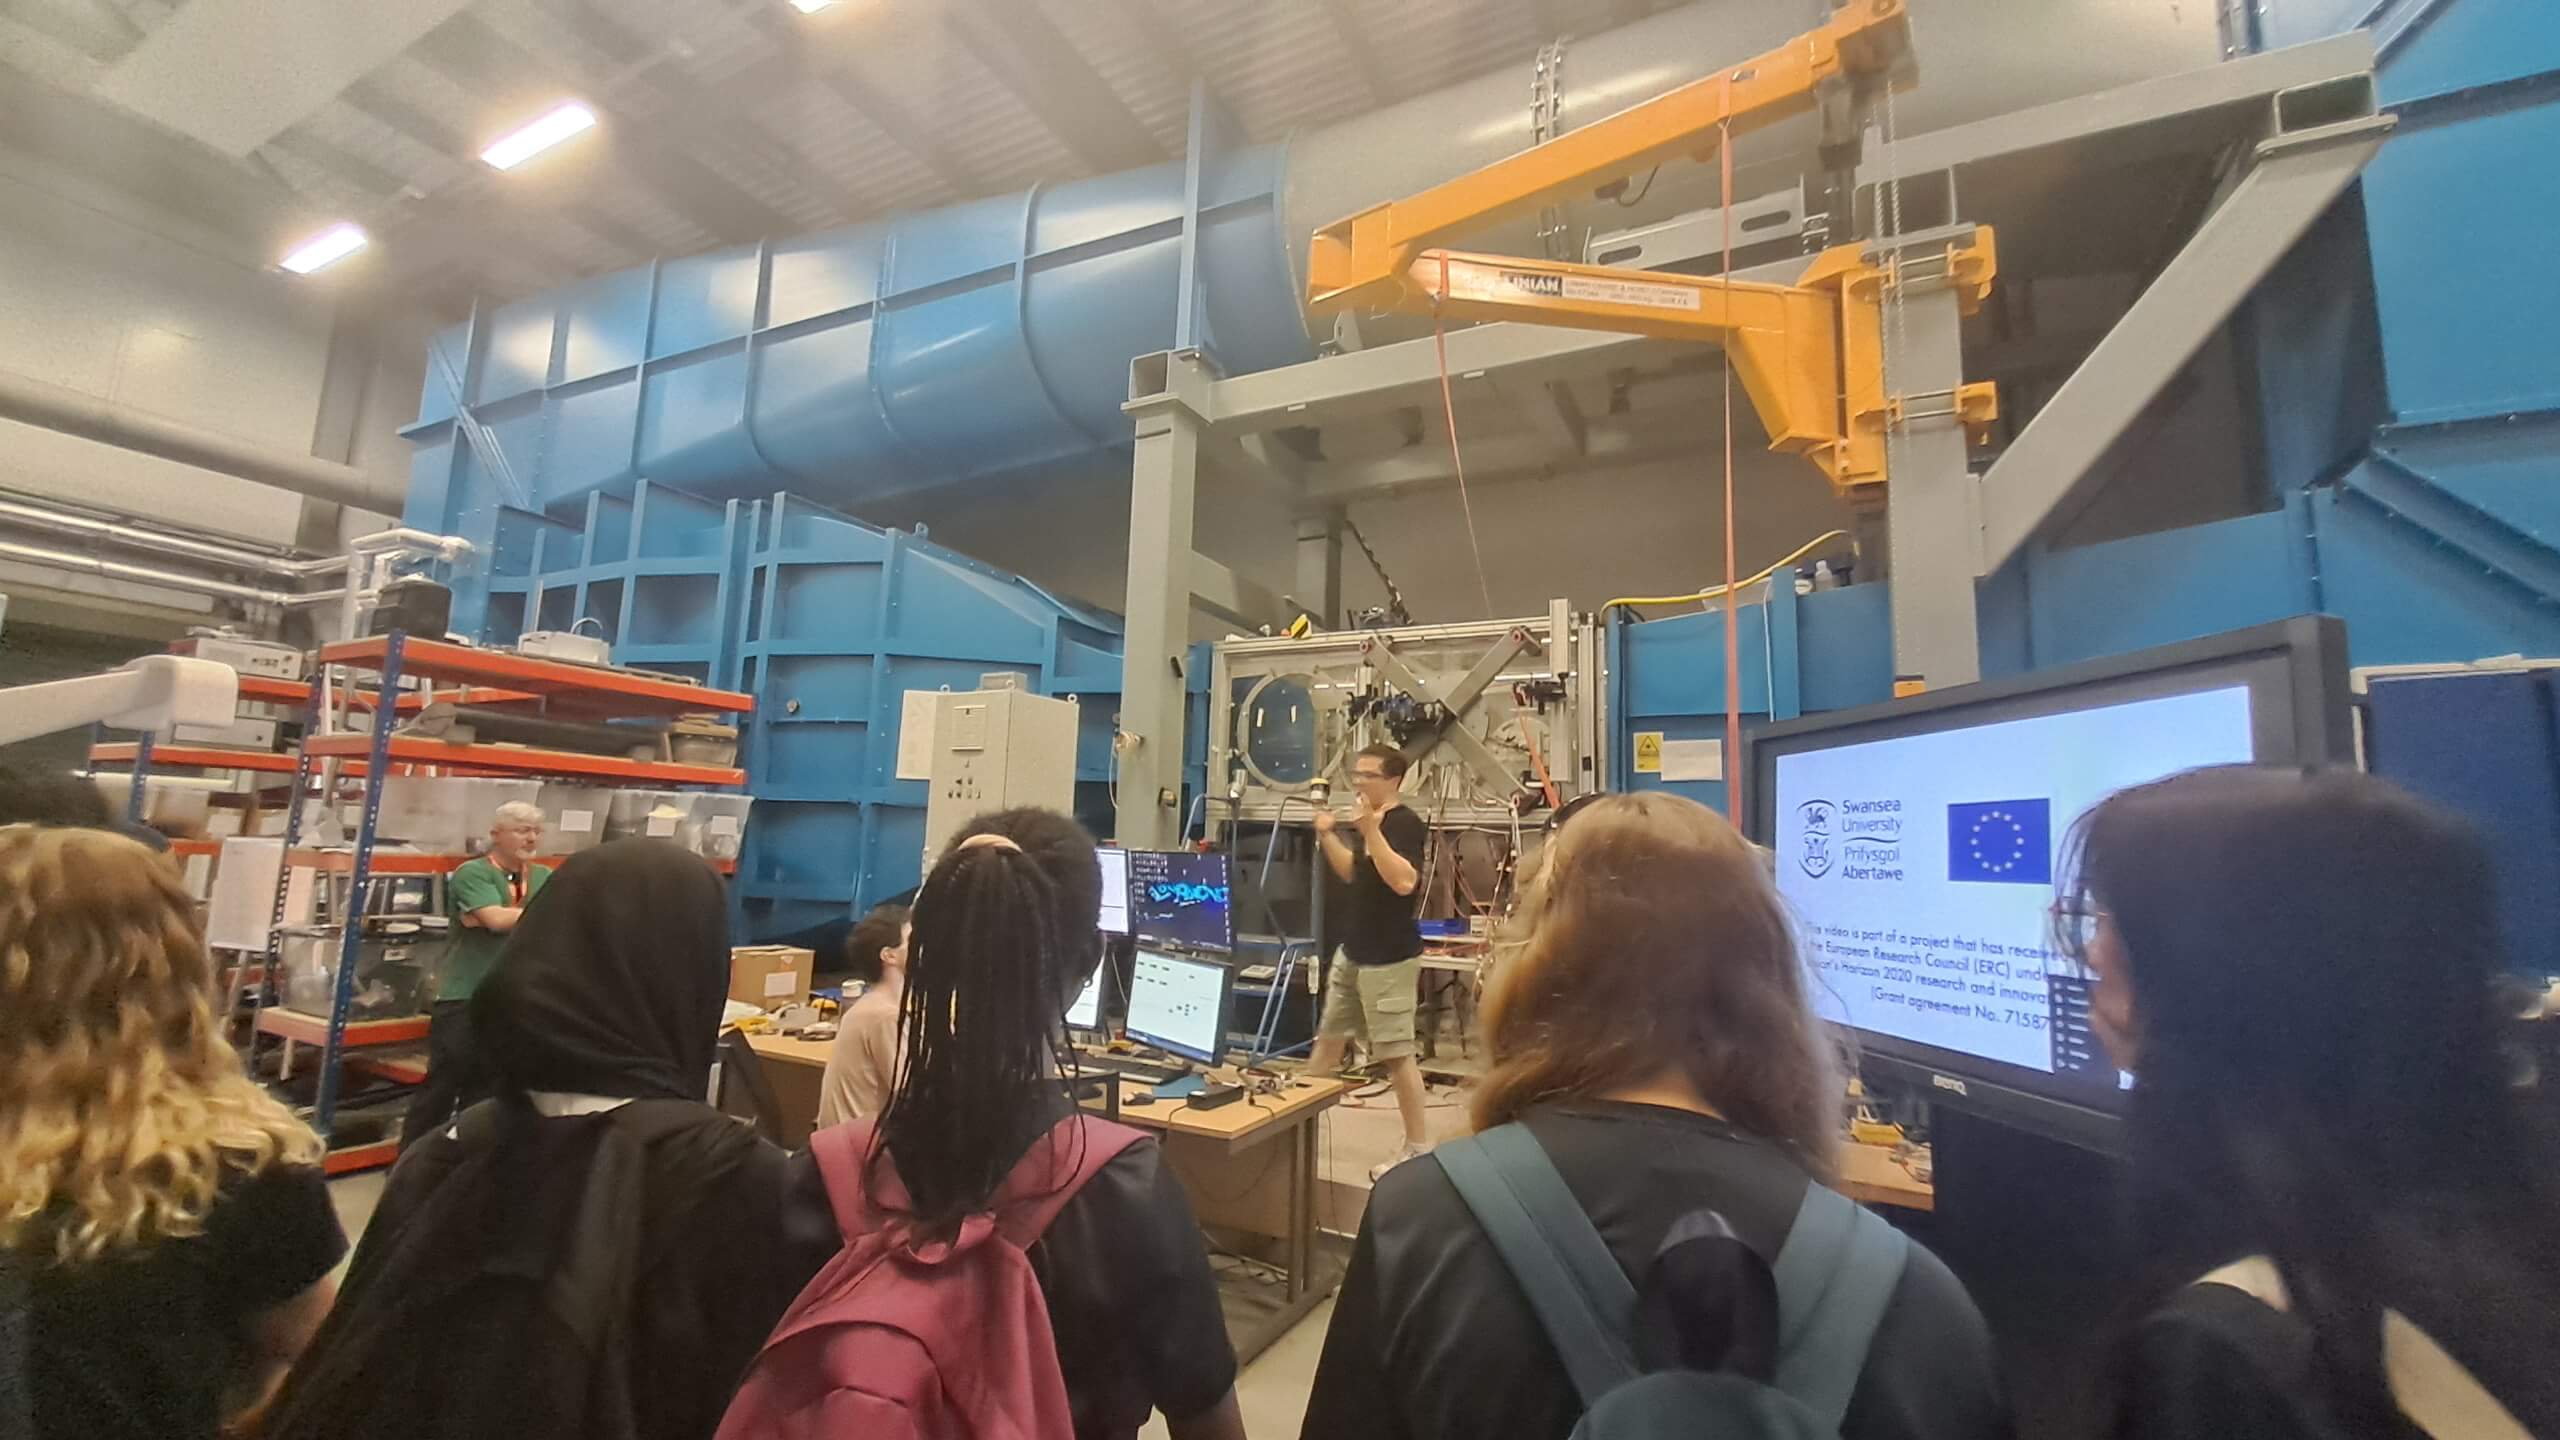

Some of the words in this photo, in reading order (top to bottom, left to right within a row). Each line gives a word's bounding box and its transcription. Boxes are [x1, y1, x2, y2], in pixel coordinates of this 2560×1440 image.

[1842, 799, 1901, 814] Swansea
[1842, 816, 1902, 834] University
[1844, 845, 1900, 865] Prifysgol
[1841, 864, 1903, 881] Abertawe
[1825, 924, 1849, 937] video
[1861, 930, 1883, 943] part
[1886, 929, 1897, 942] of
[1900, 935, 1906, 944] a
[1910, 934, 1949, 950] project
[1953, 933, 1977, 951] that
[1981, 938, 2003, 955] has
[1825, 940, 1870, 959] European
[1873, 946, 1921, 965] Research
[1925, 952, 1969, 971] Council
[1974, 959, 2010, 979] (ERC)
[1883, 966, 1913, 983] 2020
[1915, 975, 1966, 993] research
[1970, 979, 1996, 997] and
[2000, 983, 2048, 1005] innova
[1907, 996, 1971, 1018] agreement
[1975, 1005, 2000, 1024] No.
